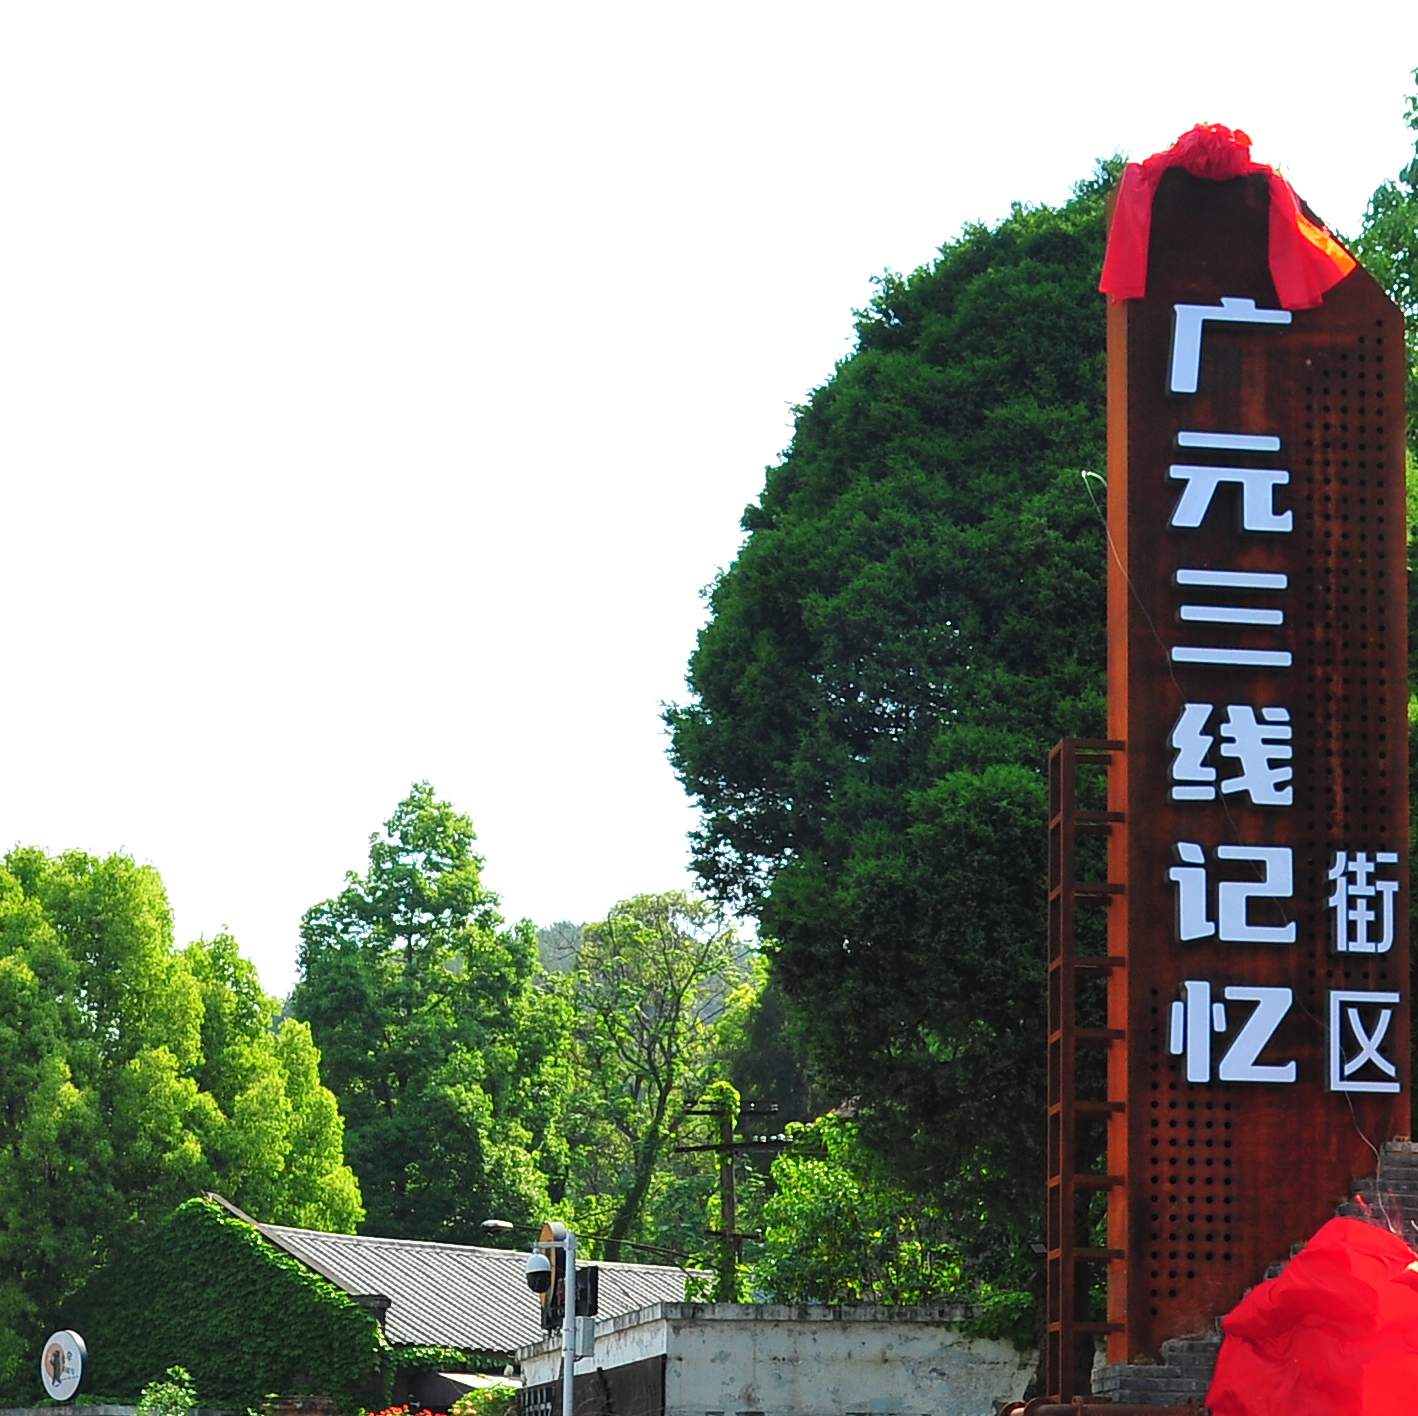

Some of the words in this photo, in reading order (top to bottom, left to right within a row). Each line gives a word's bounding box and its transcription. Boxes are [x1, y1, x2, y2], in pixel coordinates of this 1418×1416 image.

[1169, 297, 1296, 1082] 广元三线记忆
[1328, 851, 1400, 1093] 街区
